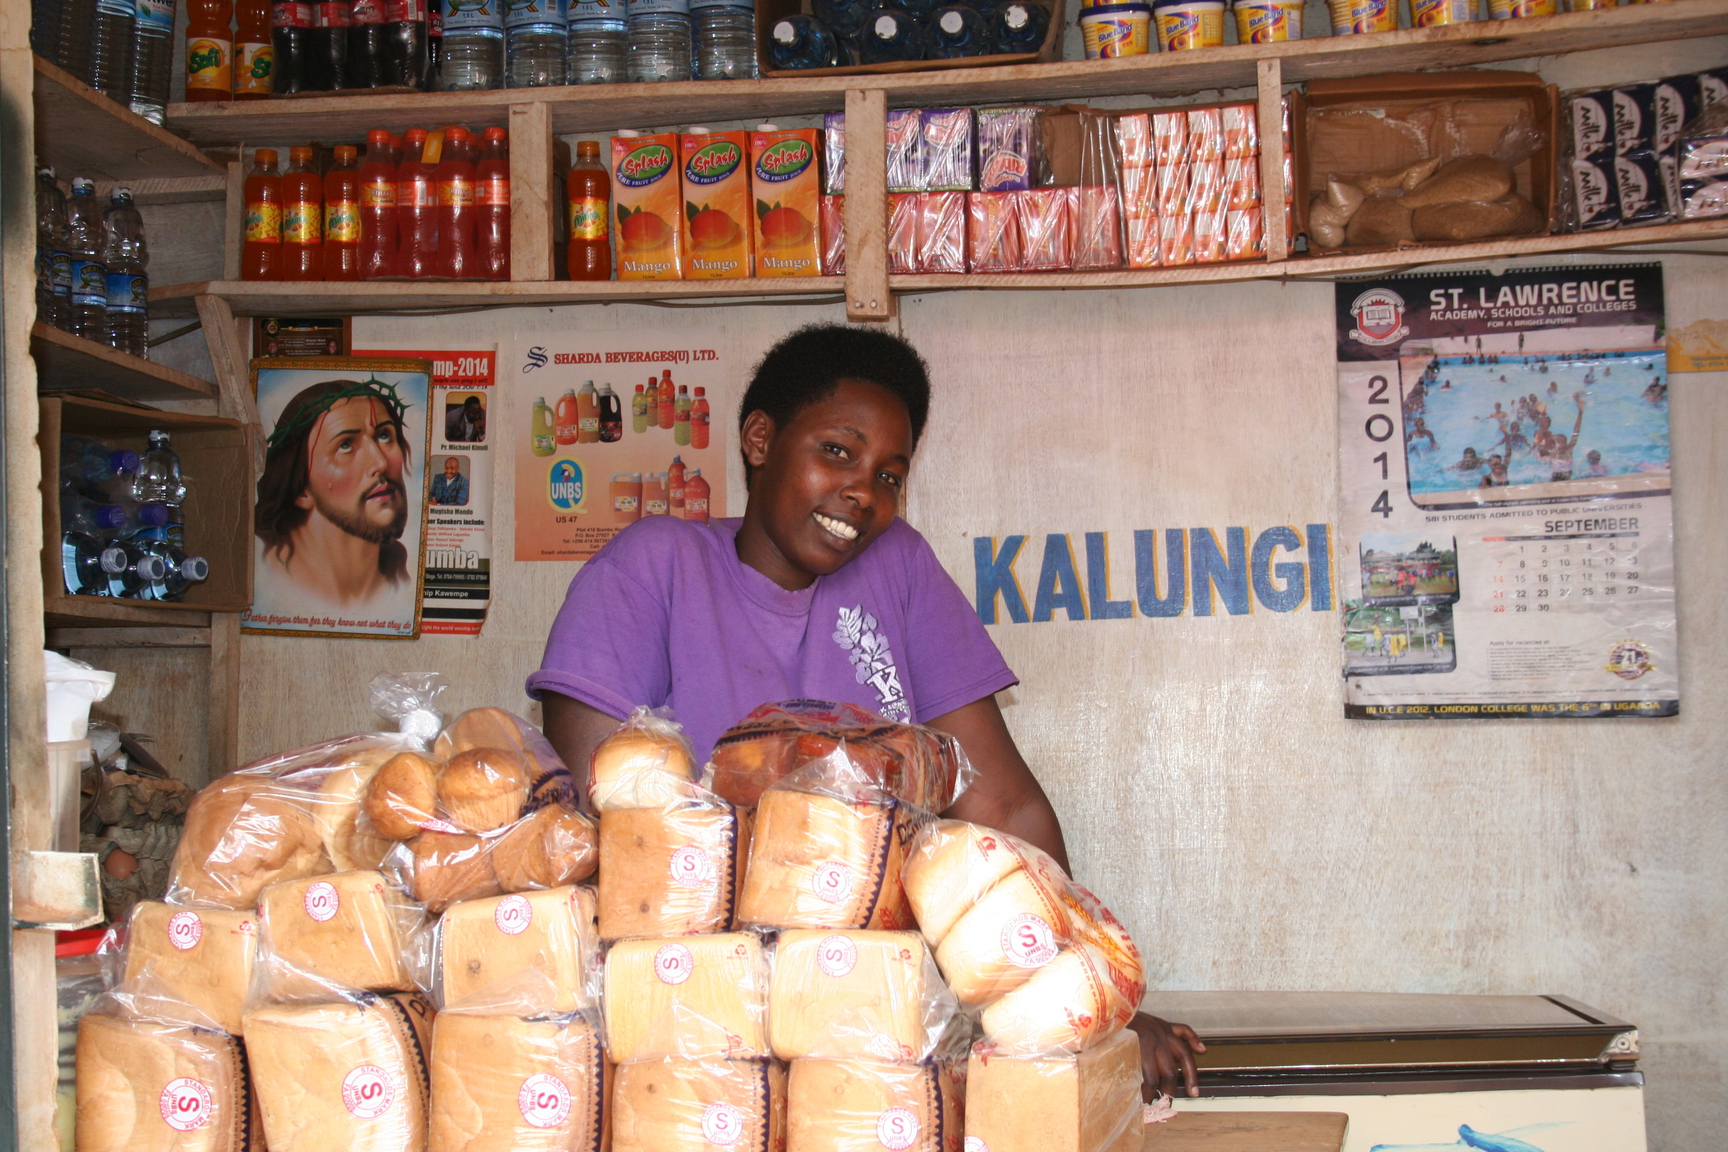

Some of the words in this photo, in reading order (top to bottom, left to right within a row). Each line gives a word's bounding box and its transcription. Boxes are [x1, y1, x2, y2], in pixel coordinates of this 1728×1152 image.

[1249, 17, 1262, 27] Blue
[1263, 8, 1283, 22] Band
[1352, 7, 1368, 17] Blue
[1098, 31, 1112, 41] Blue
[1113, 24, 1132, 37] Band
[1166, 23, 1179, 34] Blue
[1180, 15, 1199, 28] Band
[189, 48, 220, 73] Safi
[624, 148, 669, 177] Splash
[693, 146, 736, 174] Splash
[764, 143, 808, 172] Splash
[617, 172, 630, 185] PURE
[686, 169, 699, 182] PURE
[756, 167, 769, 180] PURE
[624, 260, 671, 274] Mango
[692, 258, 738, 272] Mango
[763, 256, 810, 270] Mango
[1430, 288, 1468, 310] ST.
[1479, 279, 1636, 309] LAWRENCE
[1491, 306, 1545, 318] SCHOOLS
[1548, 304, 1573, 314] AND
[1577, 301, 1637, 313] COLLEGES
[1546, 317, 1577, 325] FUTURE
[554, 352, 602, 364] SHARDA
[605, 350, 689, 364] BEVERAGES(U)
[693, 349, 719, 361] LTD.
[433, 357, 488, 378] mp-2014
[551, 482, 582, 500] UNBS
[1442, 513, 1486, 522] STUDENTS
[1489, 510, 1534, 519] ADMITTED
[1545, 518, 1639, 533] SEPTEMBER
[426, 547, 479, 569] umba
[973, 523, 1336, 625] KALUNGI
[435, 590, 469, 598] Kawempe
[268, 616, 291, 627] forgive
[293, 616, 308, 624] them
[309, 616, 321, 627] for
[322, 617, 336, 627] they
[338, 617, 355, 626] know
[369, 619, 386, 628] what
[387, 620, 401, 630] they
[403, 621, 411, 629] do
[1620, 650, 1636, 664] 21
[1380, 706, 1403, 714] U.C.E
[1434, 705, 1478, 714] LONDON
[1481, 704, 1528, 713] COLLEGE
[1531, 704, 1555, 712] WAS
[1560, 703, 1578, 712] THE
[1614, 701, 1660, 710] UGANDA
[826, 871, 840, 888] S
[1017, 925, 1037, 948] S
[826, 949, 842, 962] S
[1025, 943, 1046, 957] UNBS
[353, 1085, 362, 1105] UNBS
[361, 1082, 382, 1100] S
[178, 1096, 200, 1112] S
[537, 1092, 558, 1110] S
[716, 1112, 728, 1130] S
[891, 1117, 904, 1134] S
